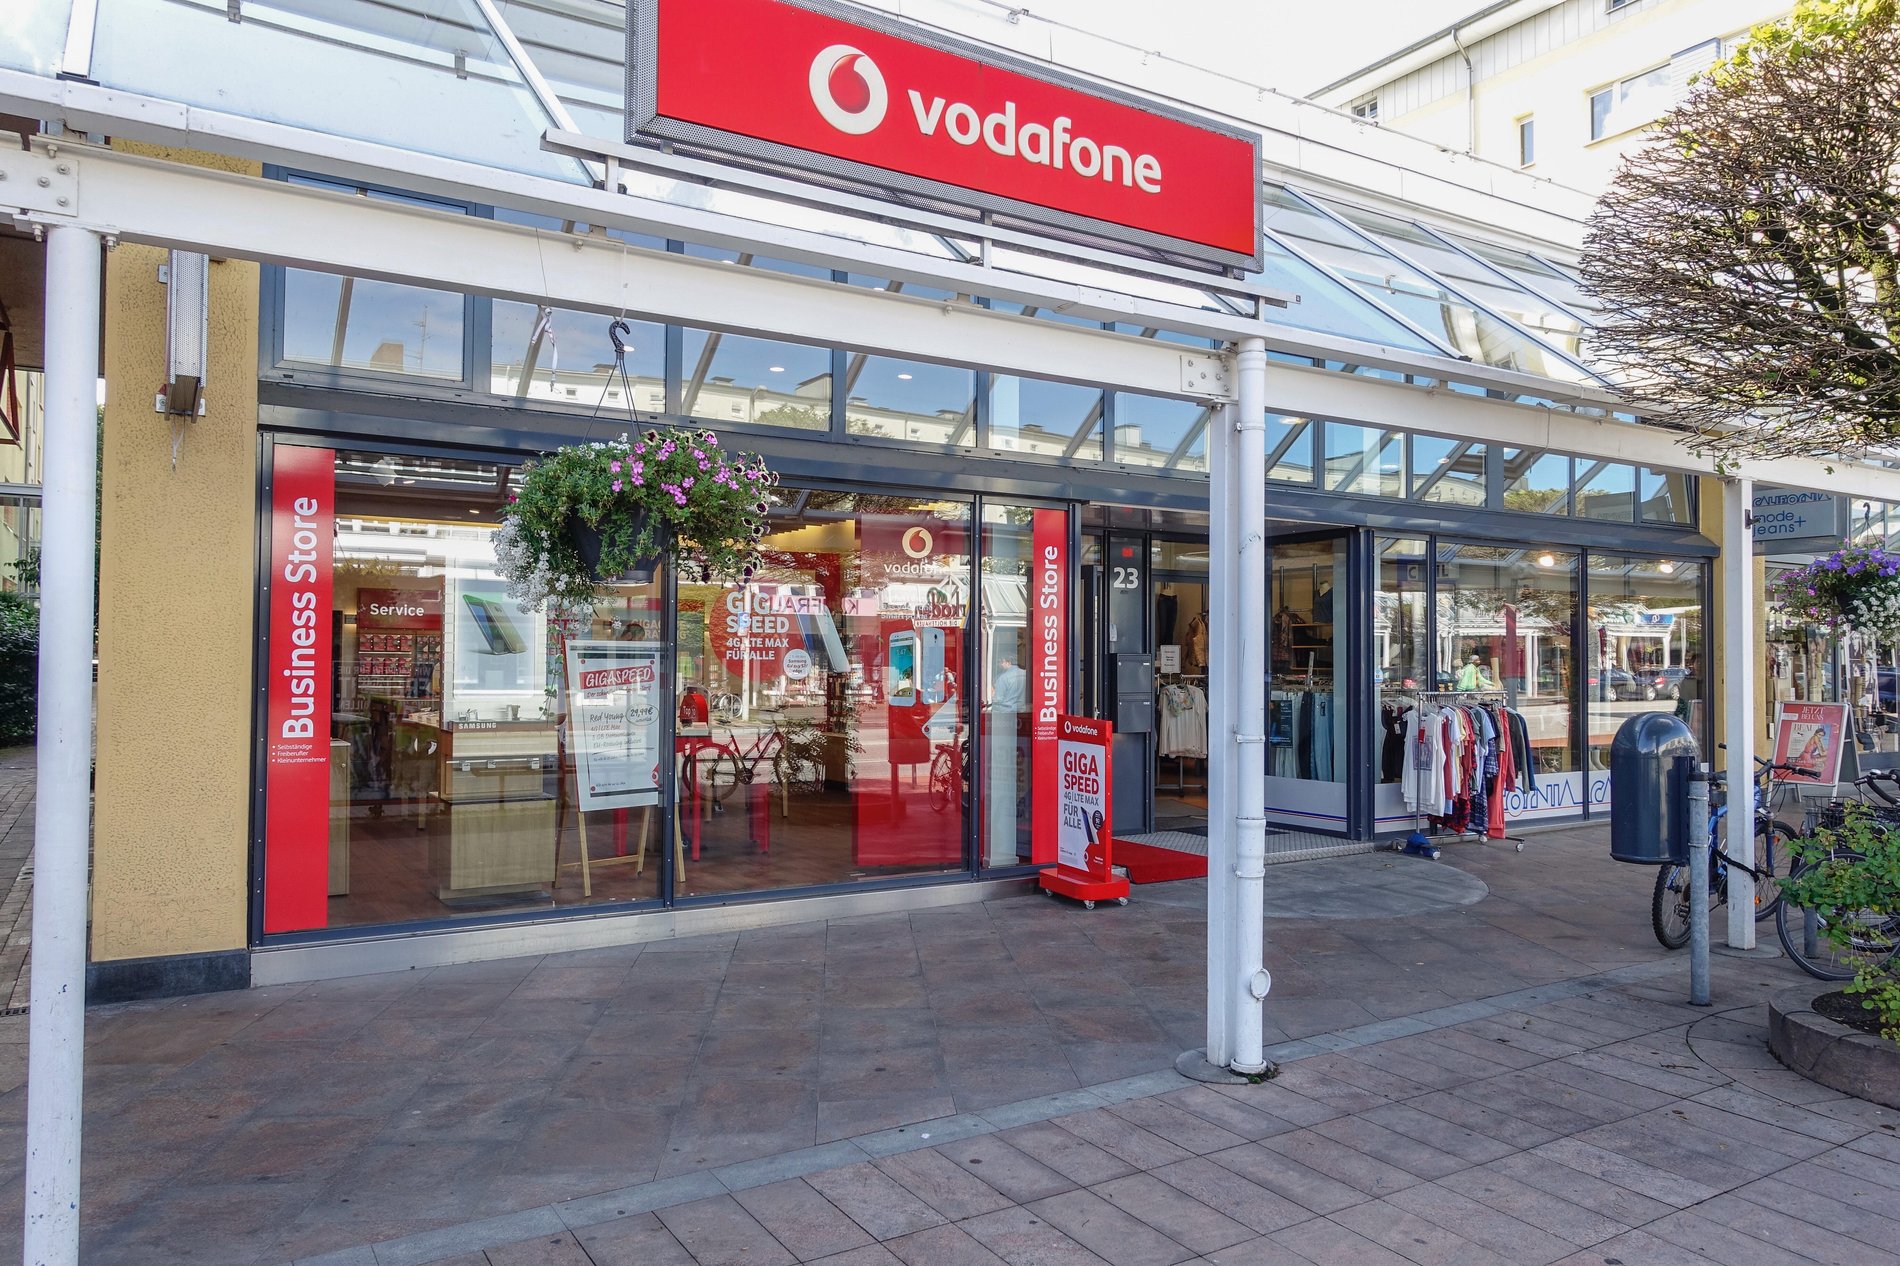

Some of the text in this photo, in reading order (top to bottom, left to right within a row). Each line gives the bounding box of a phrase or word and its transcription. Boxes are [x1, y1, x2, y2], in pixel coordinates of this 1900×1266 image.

[907, 89, 1162, 194] vodafone
[1753, 523, 1795, 537] jeans
[1113, 567, 1139, 589] 23
[282, 497, 318, 738] Business Store
[370, 604, 425, 617] Service
[727, 616, 790, 634] SPEED
[1040, 545, 1058, 722] Business Store
[765, 638, 790, 648] MAX
[749, 651, 776, 660] ALLE
[585, 667, 651, 688] GIGASPEED
[630, 706, 654, 718] 29,99€
[1801, 706, 1825, 714] JETZT
[590, 712, 603, 723] Red
[604, 712, 624, 723] Young
[458, 722, 497, 730] SAMSUNG
[1072, 725, 1098, 736] vodafone
[1063, 750, 1099, 777] GIGA
[1063, 773, 1100, 795] SPEED
[1084, 794, 1099, 807] MAX
[1063, 802, 1079, 817] FÜR
[1063, 815, 1082, 830] ALLE
